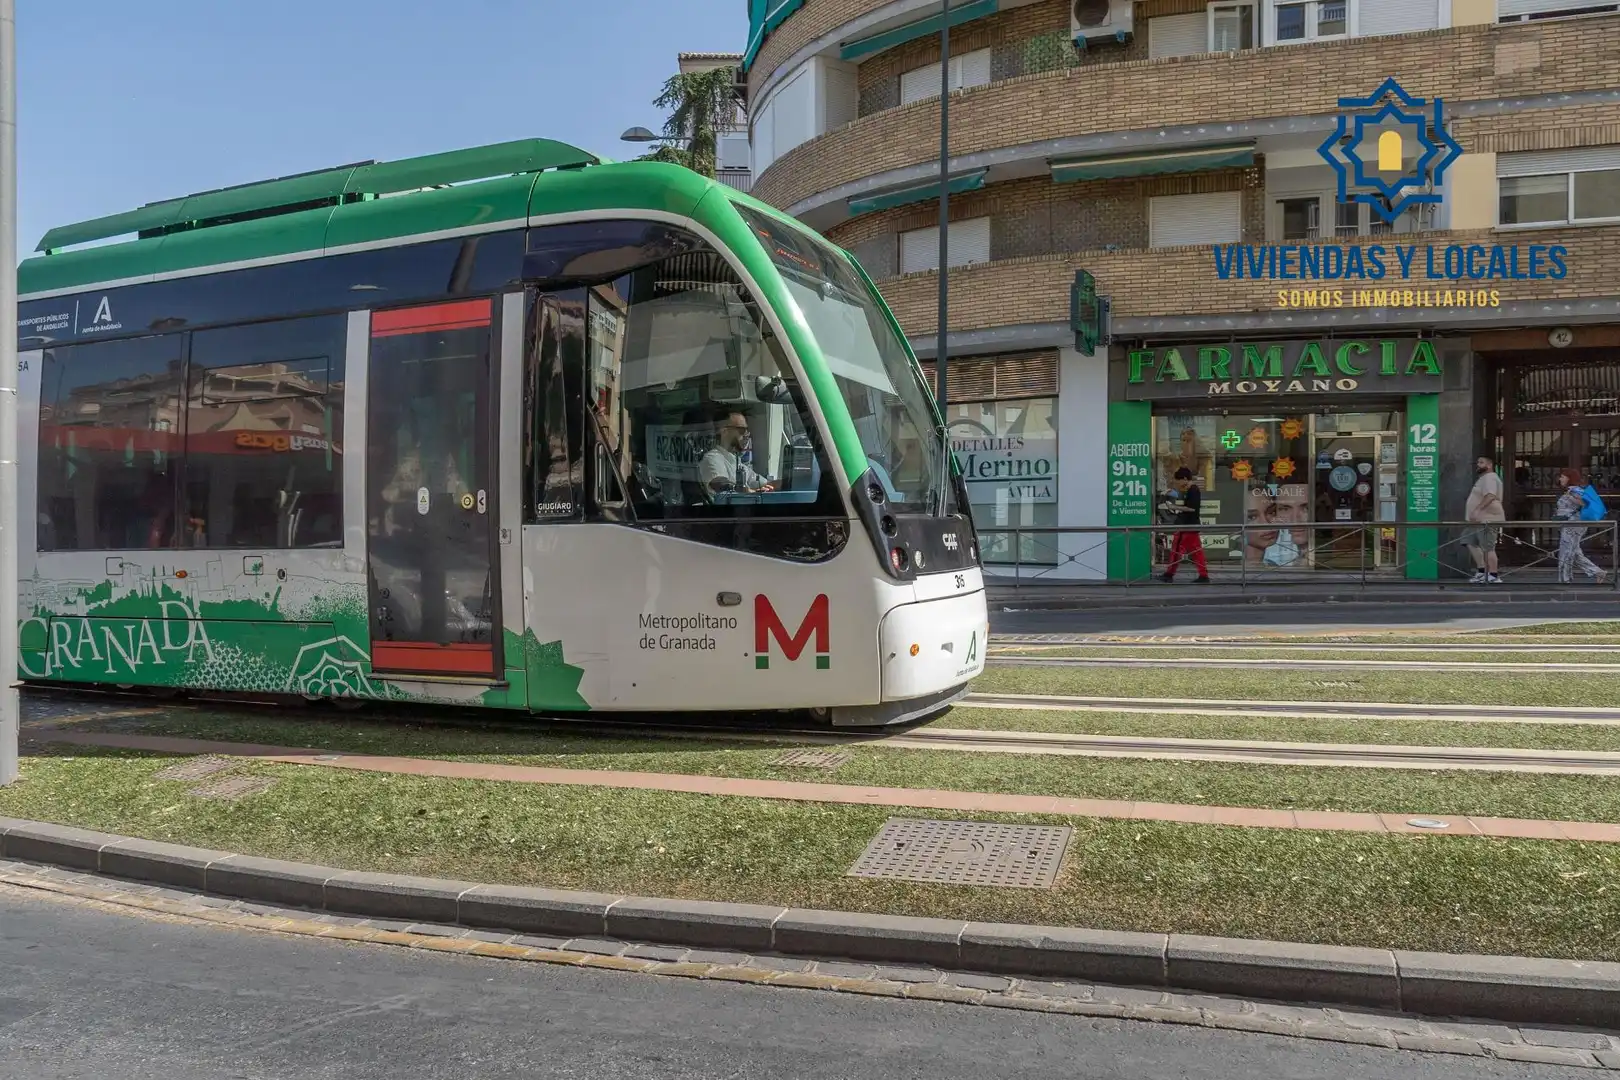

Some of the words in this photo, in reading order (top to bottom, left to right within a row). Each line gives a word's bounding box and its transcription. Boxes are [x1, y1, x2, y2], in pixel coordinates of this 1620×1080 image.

[17, 316, 46, 326] RANSPORTES
[1556, 332, 1569, 342] 12
[1128, 340, 1443, 384] FARMACIA
[1207, 378, 1358, 394] MOYANO
[1410, 423, 1436, 443] 12
[952, 436, 1024, 452] DETALLES
[1110, 443, 1150, 457] ABIERTO
[1410, 444, 1436, 452] horas
[954, 452, 1051, 478] Merino
[1112, 460, 1137, 476] 9h
[1139, 467, 1147, 476] a
[1007, 482, 1052, 498] ÁVILA
[1112, 480, 1147, 496] 21h
[537, 502, 571, 510] GIUGIARO
[639, 612, 738, 632] Metropolitano
[17, 600, 218, 677] GRANADA
[639, 633, 656, 649] de
[659, 633, 716, 650] Granada
